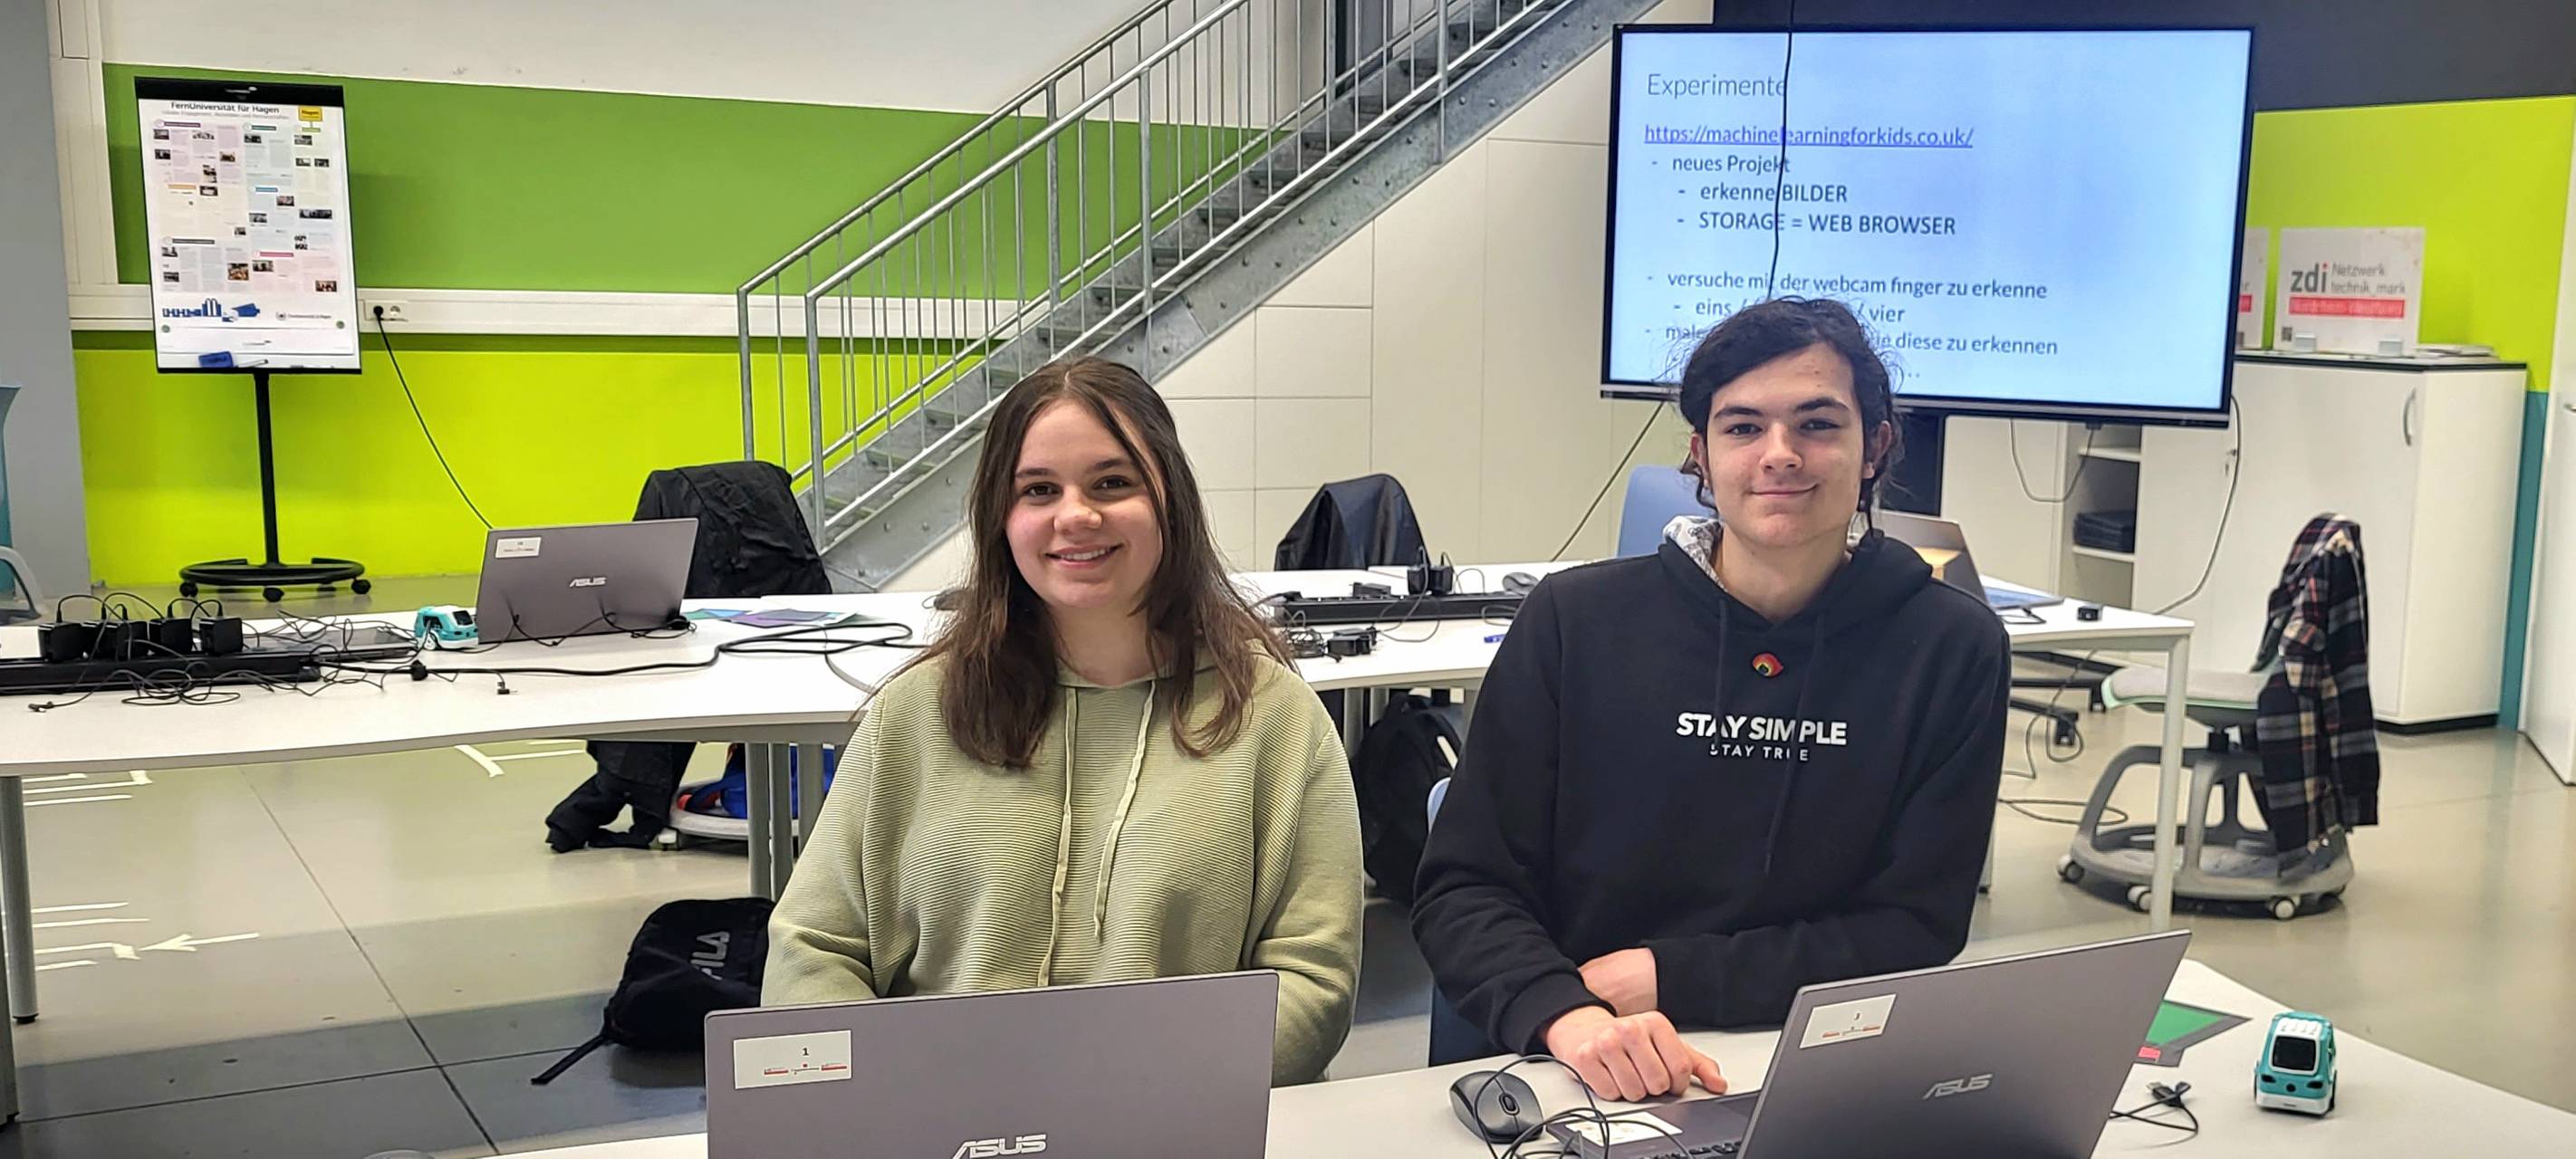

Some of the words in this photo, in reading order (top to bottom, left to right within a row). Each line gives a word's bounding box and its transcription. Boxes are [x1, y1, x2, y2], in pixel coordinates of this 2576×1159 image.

[1647, 72, 1787, 100] Experimente
[170, 101, 235, 112] FernUniversität
[237, 105, 250, 113] für
[253, 106, 280, 115] Hagen
[1672, 158, 1722, 172] neues
[1727, 155, 1791, 176] Projekt
[1700, 183, 1775, 202] erkenne
[1783, 185, 1848, 203] BILDER
[1699, 212, 1785, 232] STORAGE
[1809, 214, 1852, 233] WEB
[1860, 216, 1956, 235] BROWSER
[2291, 263, 2328, 293] zdi
[2332, 263, 2385, 276] Netzwerk
[1668, 272, 1745, 288] versuche
[1748, 273, 1774, 289] mi
[1781, 273, 1810, 291] der
[1813, 275, 1887, 292] webcam
[1891, 276, 1942, 298] finger
[1947, 283, 1967, 296] zu
[1972, 280, 2048, 298] erkenne
[1696, 299, 1731, 315] eins
[1870, 305, 1905, 321] vier
[1896, 332, 1942, 350] diese
[1947, 340, 1966, 351] zu
[1971, 336, 2058, 355] erkennen
[569, 577, 607, 588] ASUS
[1676, 713, 1747, 739] STAY
[1748, 716, 1848, 745] SIMPLE
[802, 1047, 809, 1056] 1
[1922, 1073, 1994, 1100] ASUS
[952, 1134, 1047, 1159] ASUS
